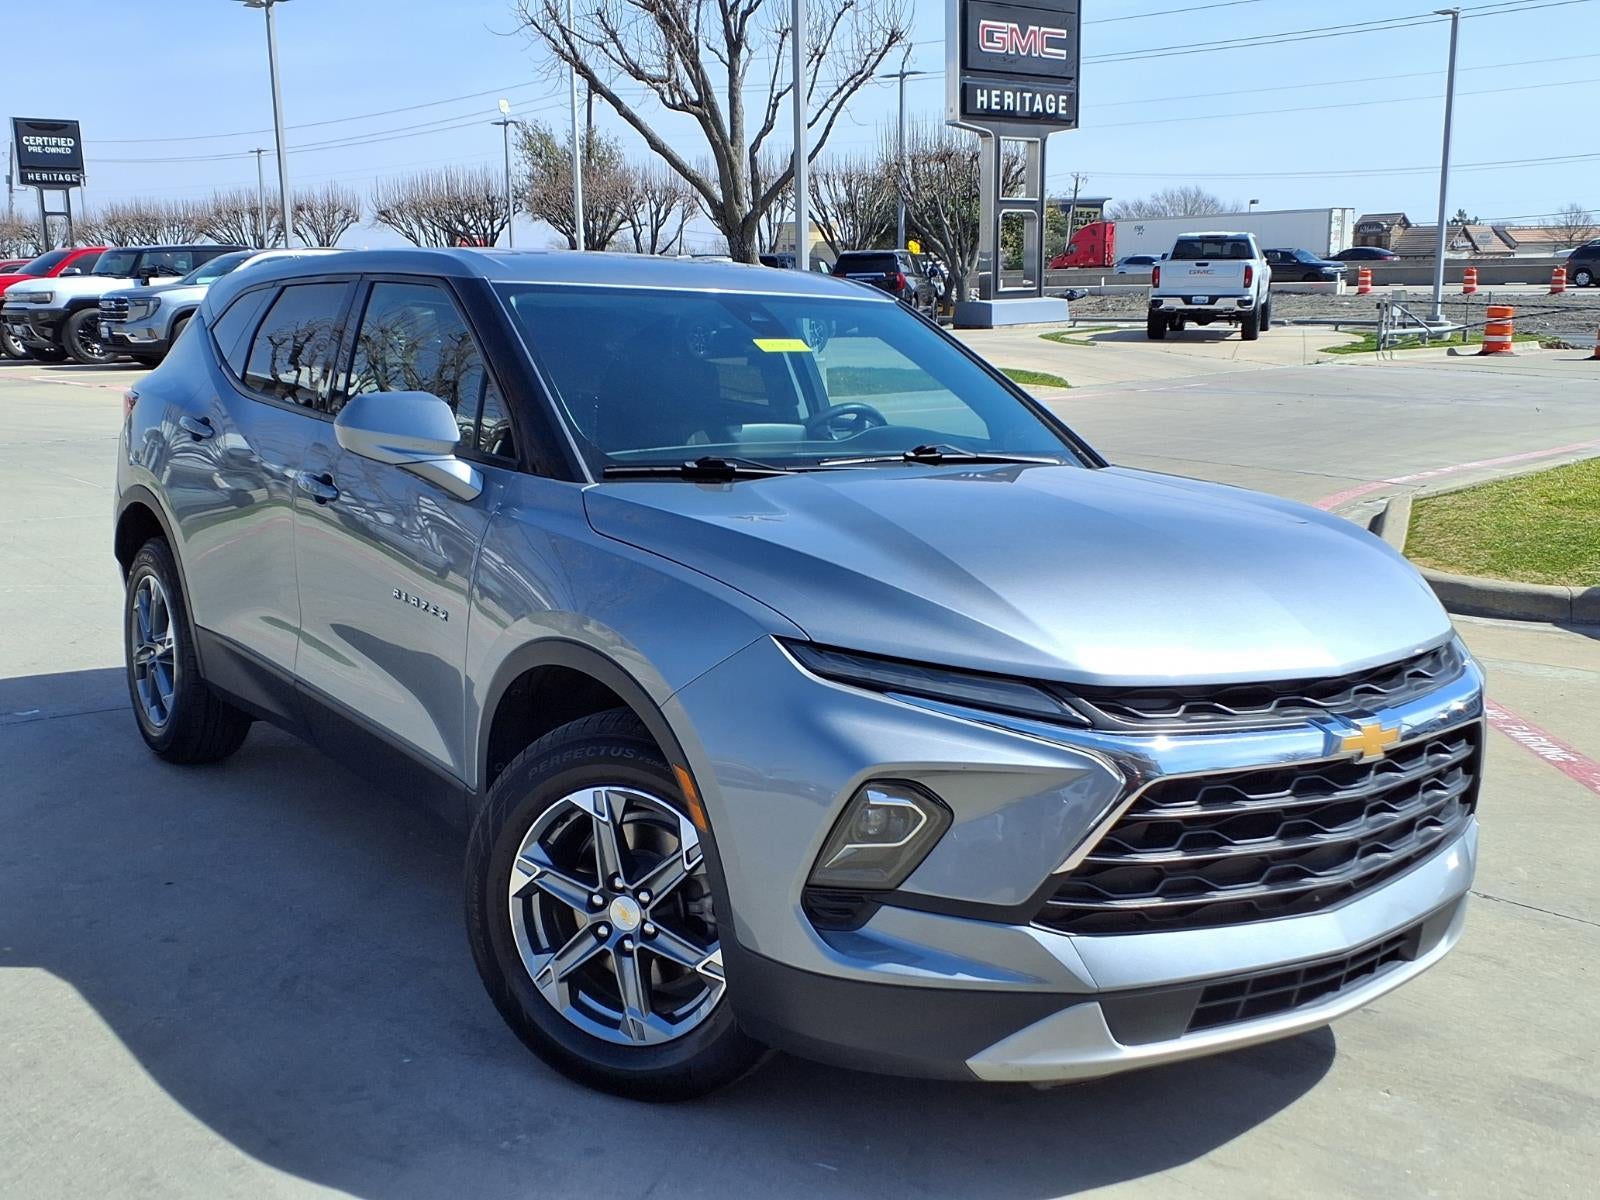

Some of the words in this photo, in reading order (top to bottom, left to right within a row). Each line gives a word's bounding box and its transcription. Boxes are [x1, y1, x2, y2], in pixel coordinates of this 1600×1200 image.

[979, 19, 1067, 60] GMC
[976, 88, 1068, 115] HERITAGE
[22, 136, 75, 147] CERTIFIED
[27, 146, 71, 154] PRE-OWNED
[27, 172, 79, 182] HERITAGE
[392, 587, 449, 622] BLAZER
[528, 745, 637, 778] PERFECTUS
